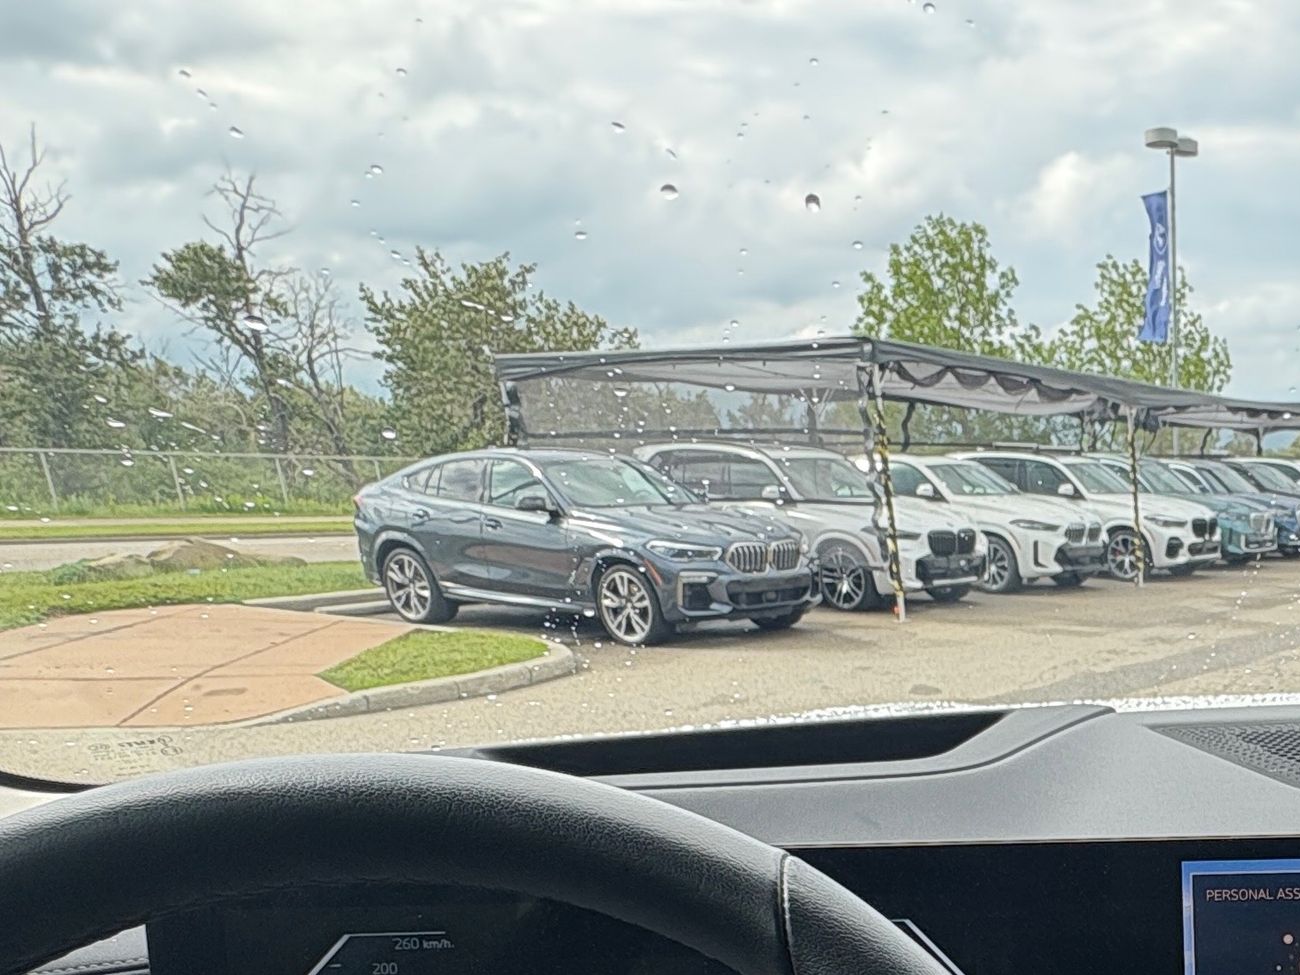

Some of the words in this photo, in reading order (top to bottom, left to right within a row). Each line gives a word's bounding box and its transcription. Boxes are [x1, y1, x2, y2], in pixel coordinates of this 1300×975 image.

[1206, 888, 1273, 901] PERSONAL
[392, 937, 420, 950] 260
[371, 962, 398, 975] 200
